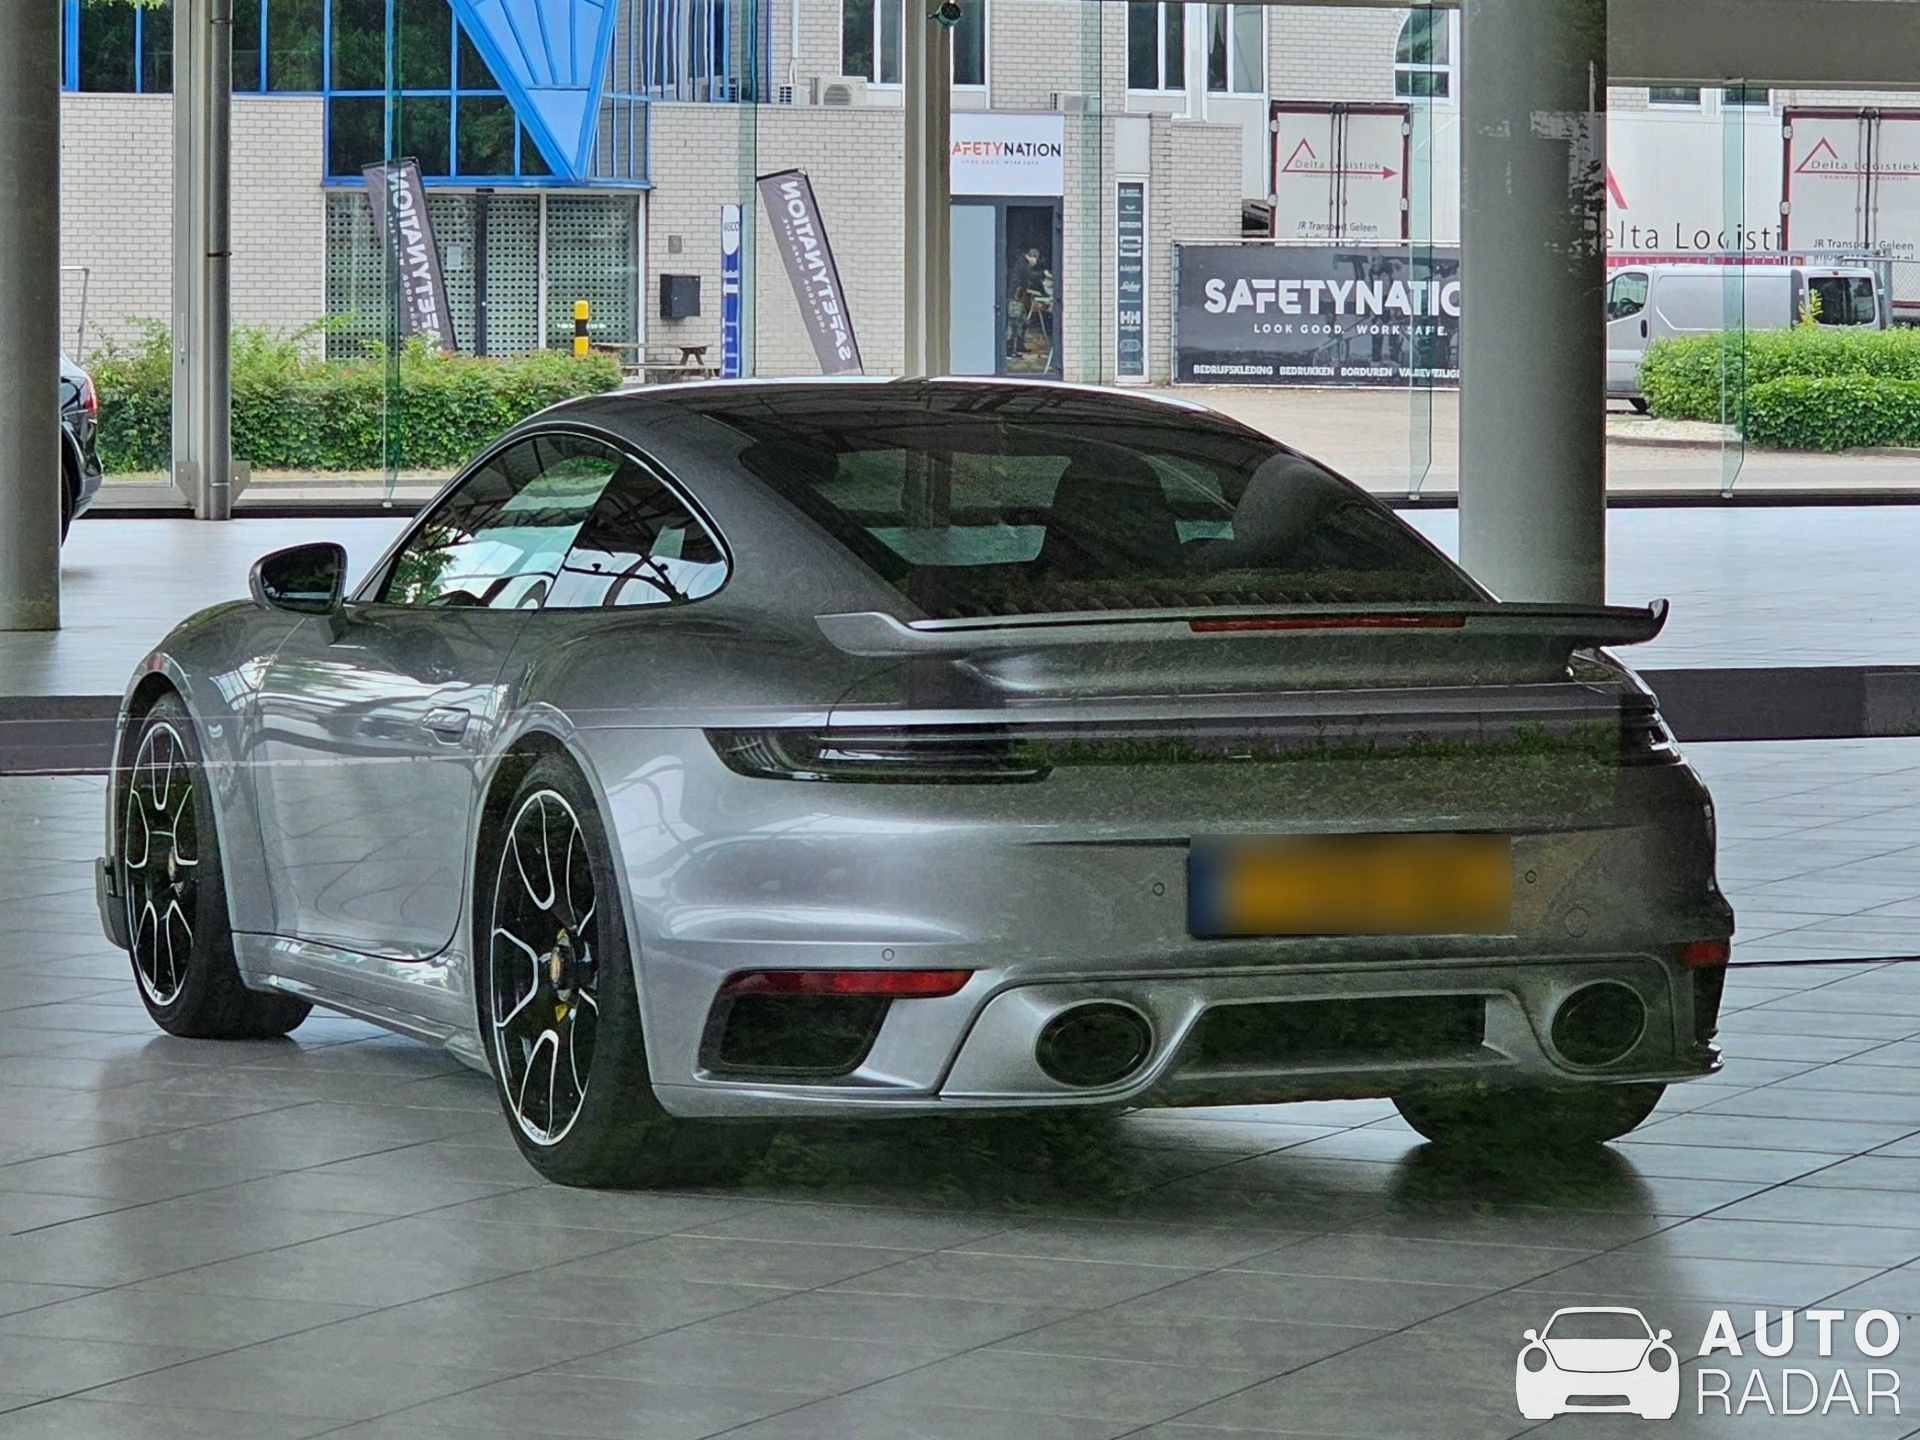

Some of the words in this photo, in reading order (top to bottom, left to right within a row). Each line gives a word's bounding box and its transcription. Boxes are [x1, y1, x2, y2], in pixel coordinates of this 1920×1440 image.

[951, 141, 1062, 157] AFETYNATION
[1294, 160, 1325, 169] Delta
[1811, 160, 1848, 170] Delta
[1297, 221, 1307, 231] JR
[1349, 222, 1378, 232] Geleen
[1813, 239, 1825, 249] JR
[1827, 239, 1874, 250] Transpot
[1878, 240, 1914, 251] Geleen
[1254, 323, 1293, 334] LOOK
[1300, 324, 1345, 335] GOOD.
[1356, 325, 1400, 335] WORK
[1279, 366, 1335, 377] BEDRUKKEN
[1340, 366, 1393, 377] BORDUREN
